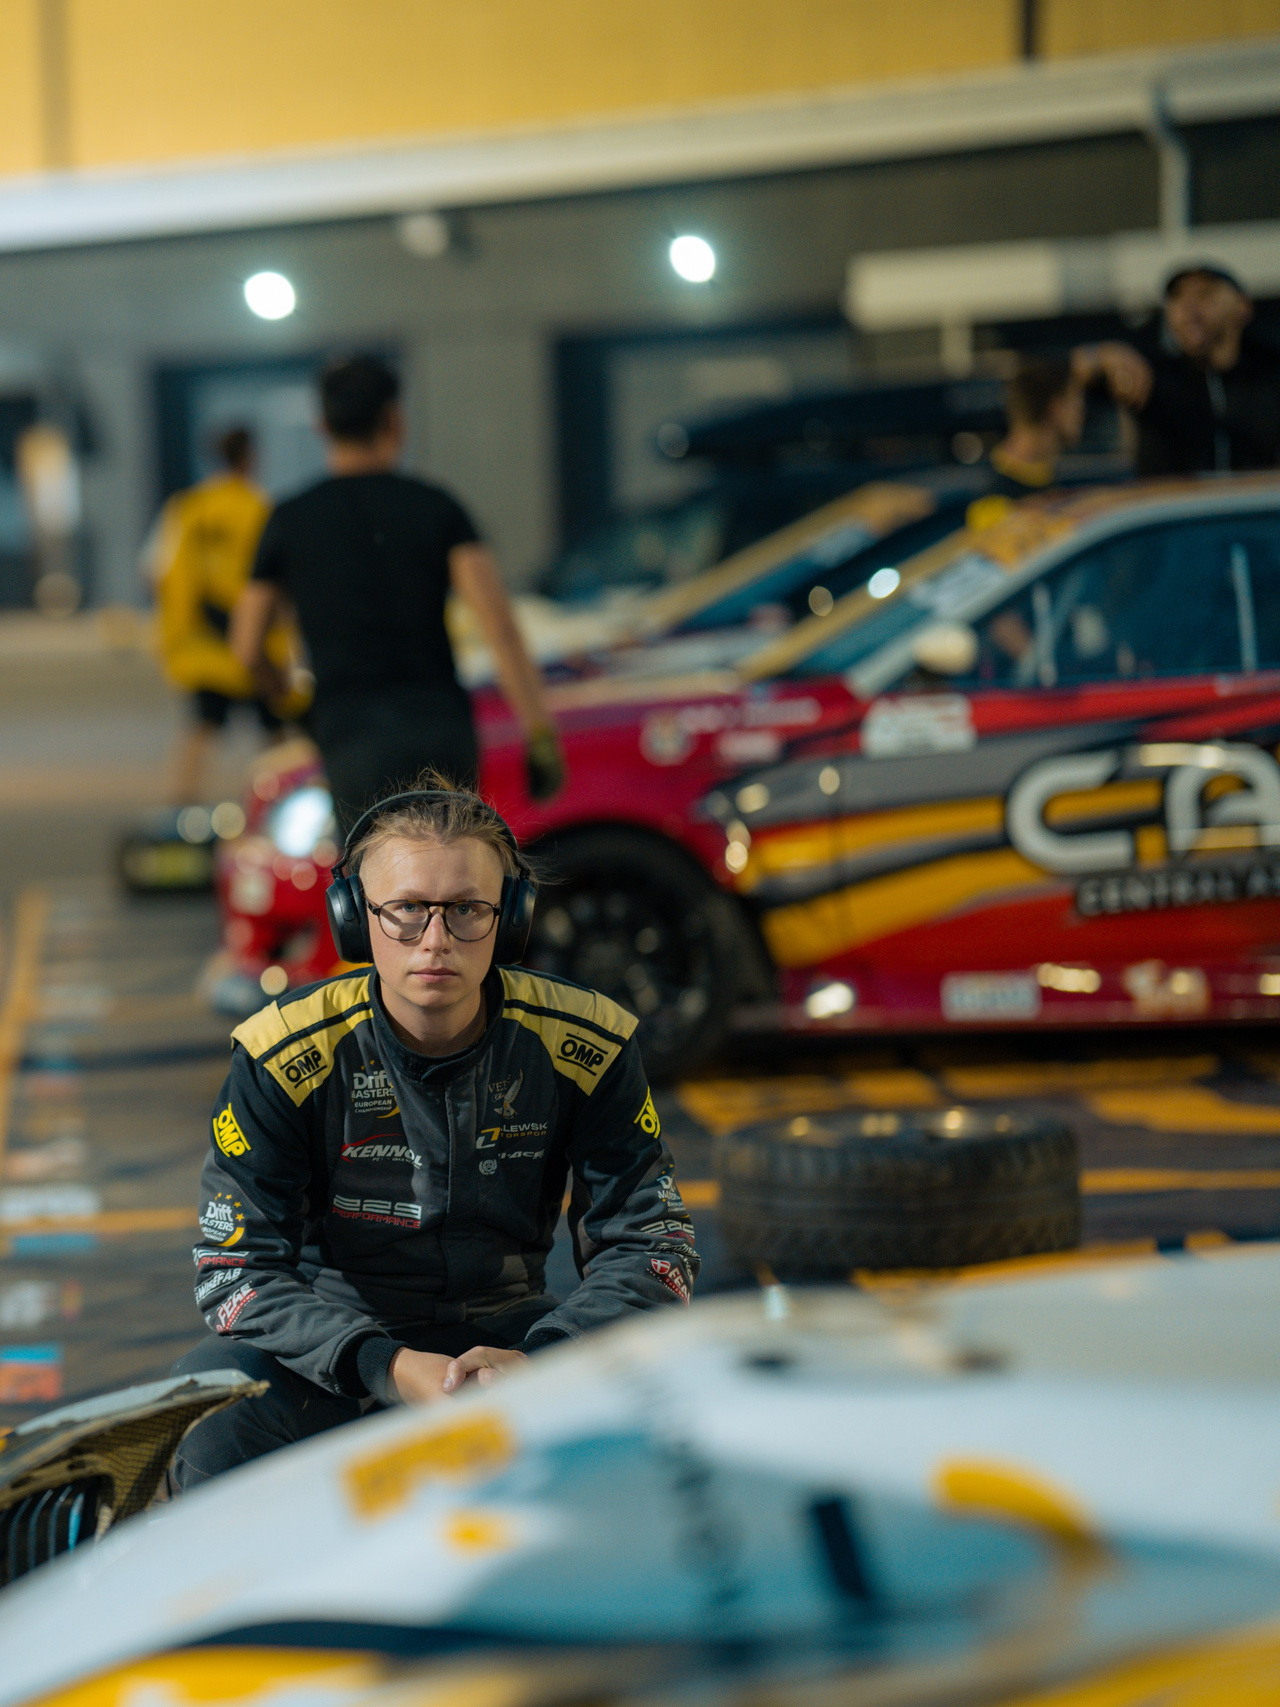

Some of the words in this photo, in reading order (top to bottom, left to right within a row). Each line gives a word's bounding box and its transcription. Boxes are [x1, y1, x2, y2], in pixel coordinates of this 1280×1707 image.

[560, 1039, 604, 1068] OMP
[285, 1050, 322, 1083] OMP
[354, 1099, 392, 1108] EUROPEAN
[218, 1109, 245, 1156] OMP
[341, 1145, 422, 1167] KENNOL
[205, 1201, 233, 1222] Drift
[332, 1207, 421, 1229] PERFORMANCE
